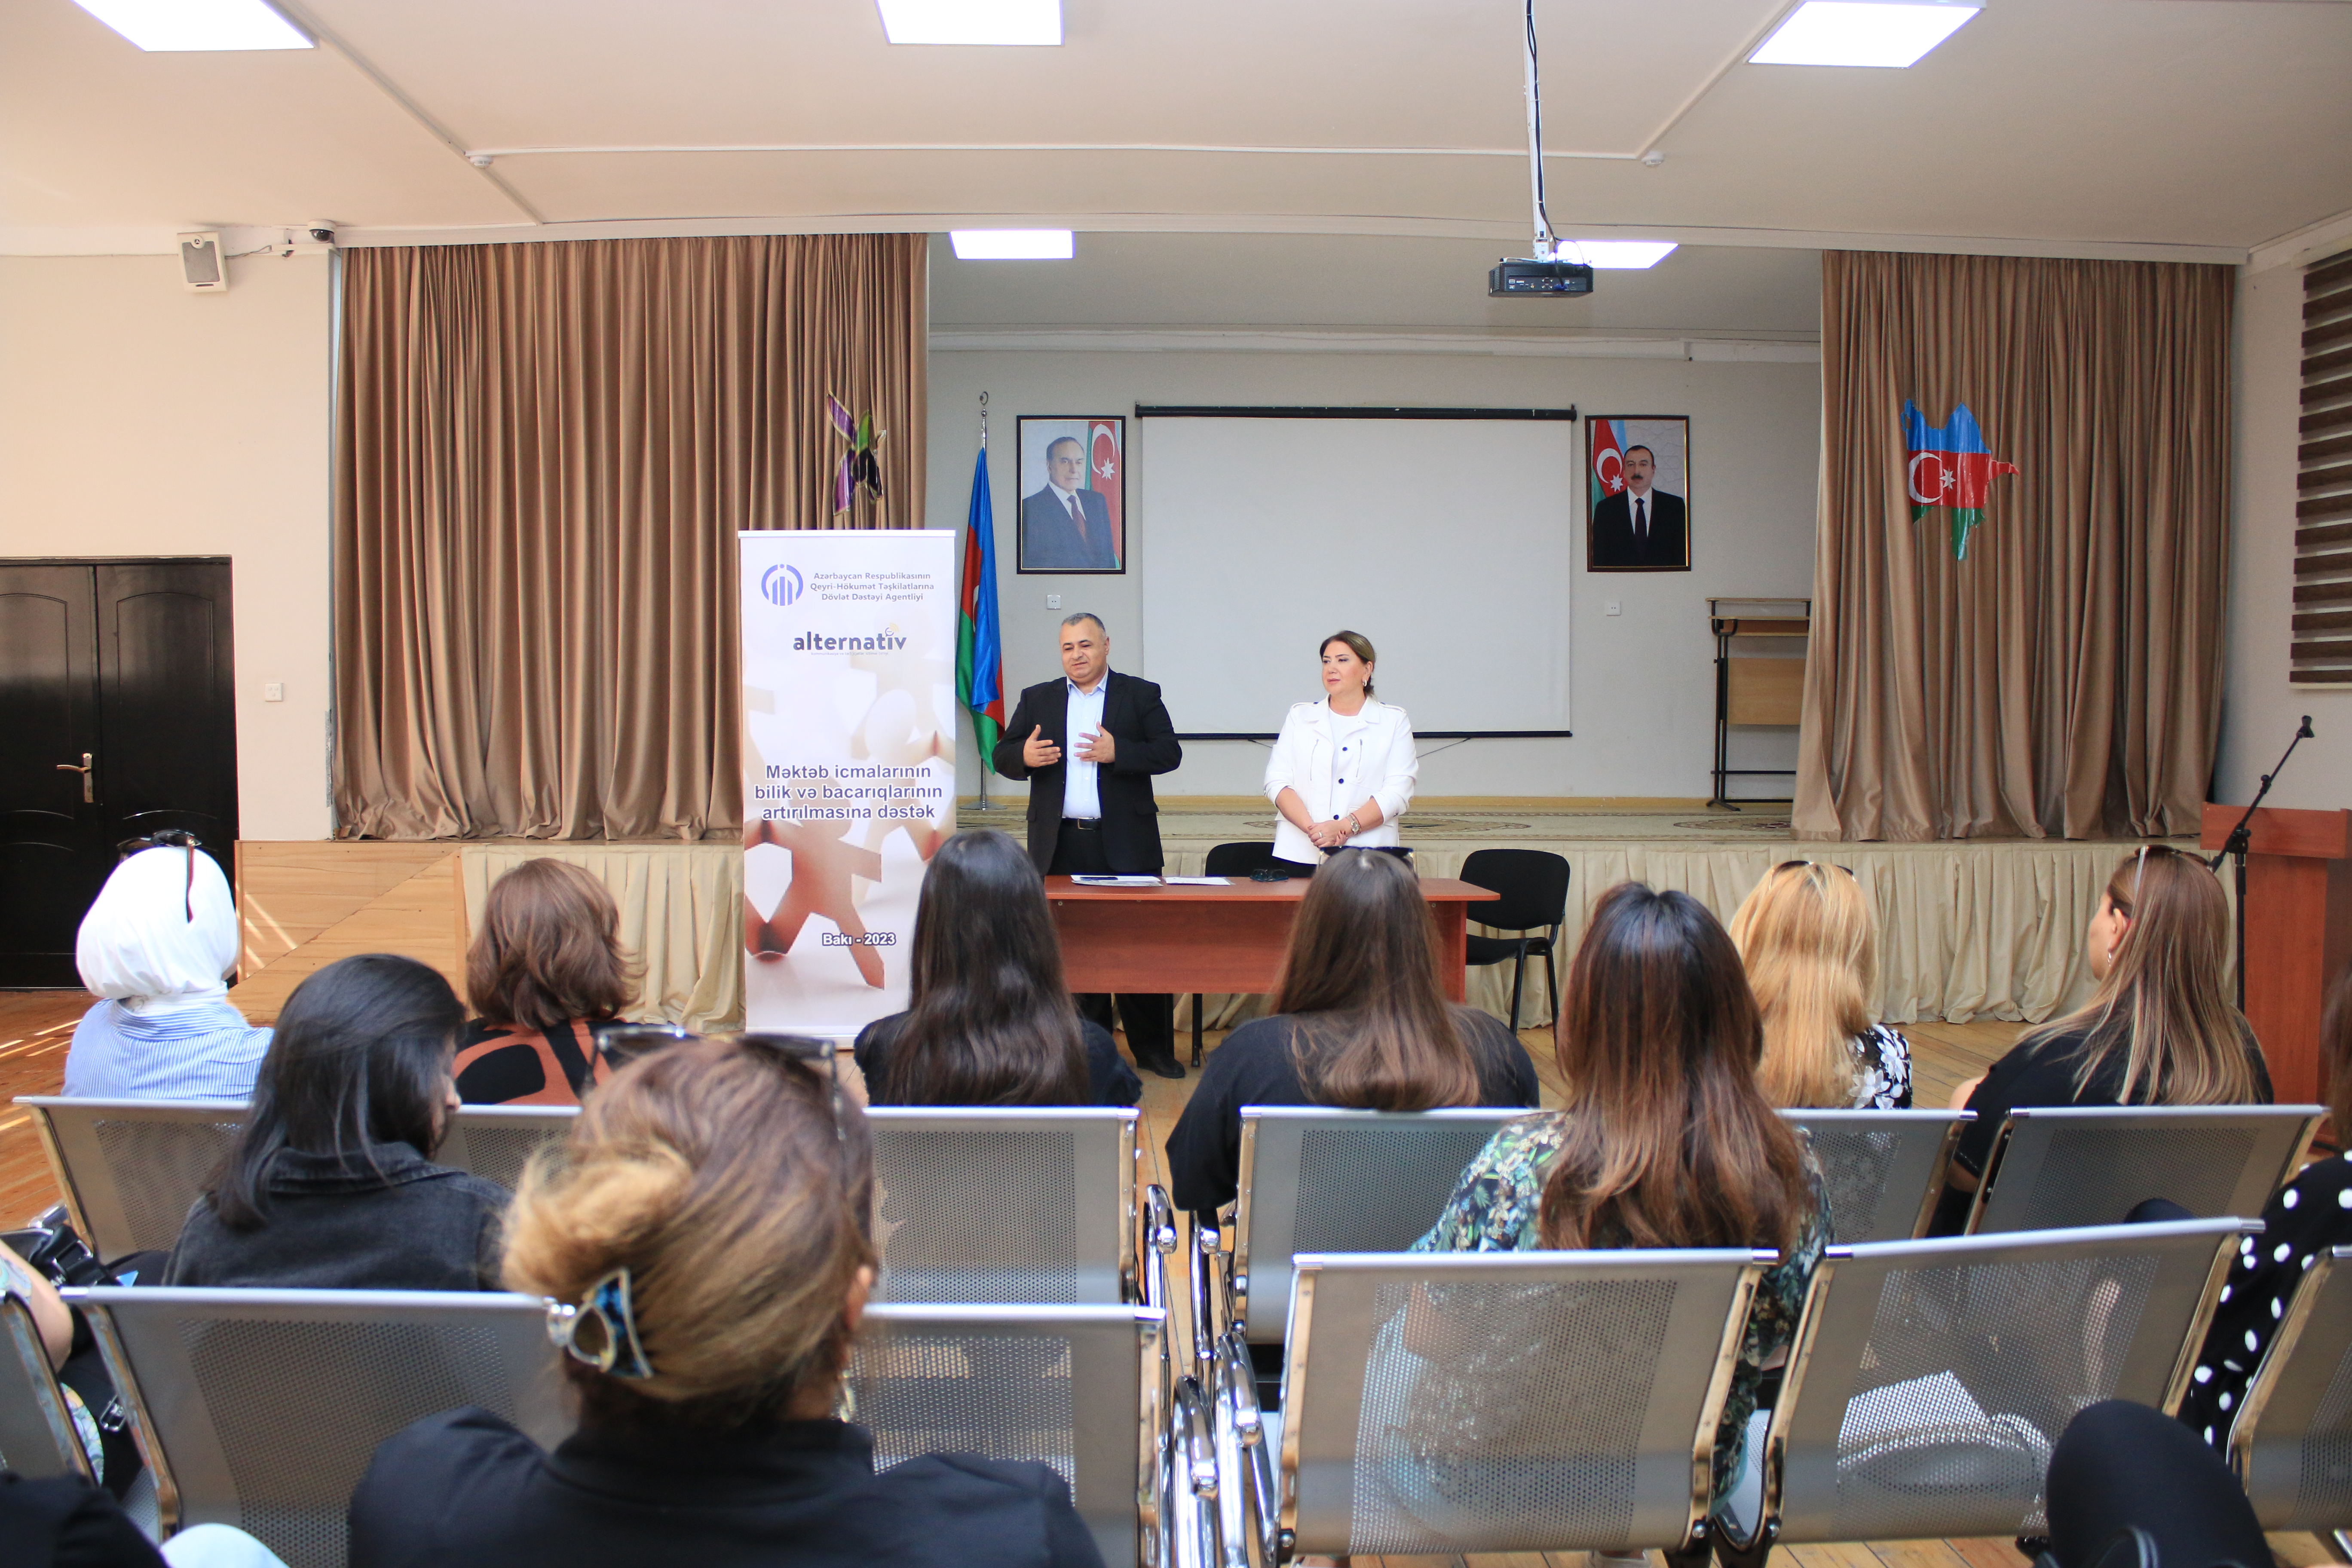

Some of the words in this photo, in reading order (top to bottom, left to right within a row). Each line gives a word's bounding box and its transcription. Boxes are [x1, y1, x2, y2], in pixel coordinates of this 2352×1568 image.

[813, 572, 862, 582] Azərbaycan
[865, 572, 931, 582] Respublikasının
[810, 582, 876, 592] Qeyri-Hökumət
[878, 582, 934, 592] Təşkilatlarına
[852, 593, 882, 602] Dəstəyi
[885, 593, 923, 602] Agentliyi
[793, 631, 907, 650] alternativ
[766, 765, 829, 779] Məktəb
[835, 764, 931, 778] icmalarının
[755, 785, 791, 799] bilik
[796, 788, 817, 798] və
[823, 784, 943, 801] bacarıqlarının
[763, 805, 872, 820] artırılmasına
[877, 805, 935, 818] dəstək
[822, 934, 852, 946] Bakı
[864, 933, 896, 946] 2023
